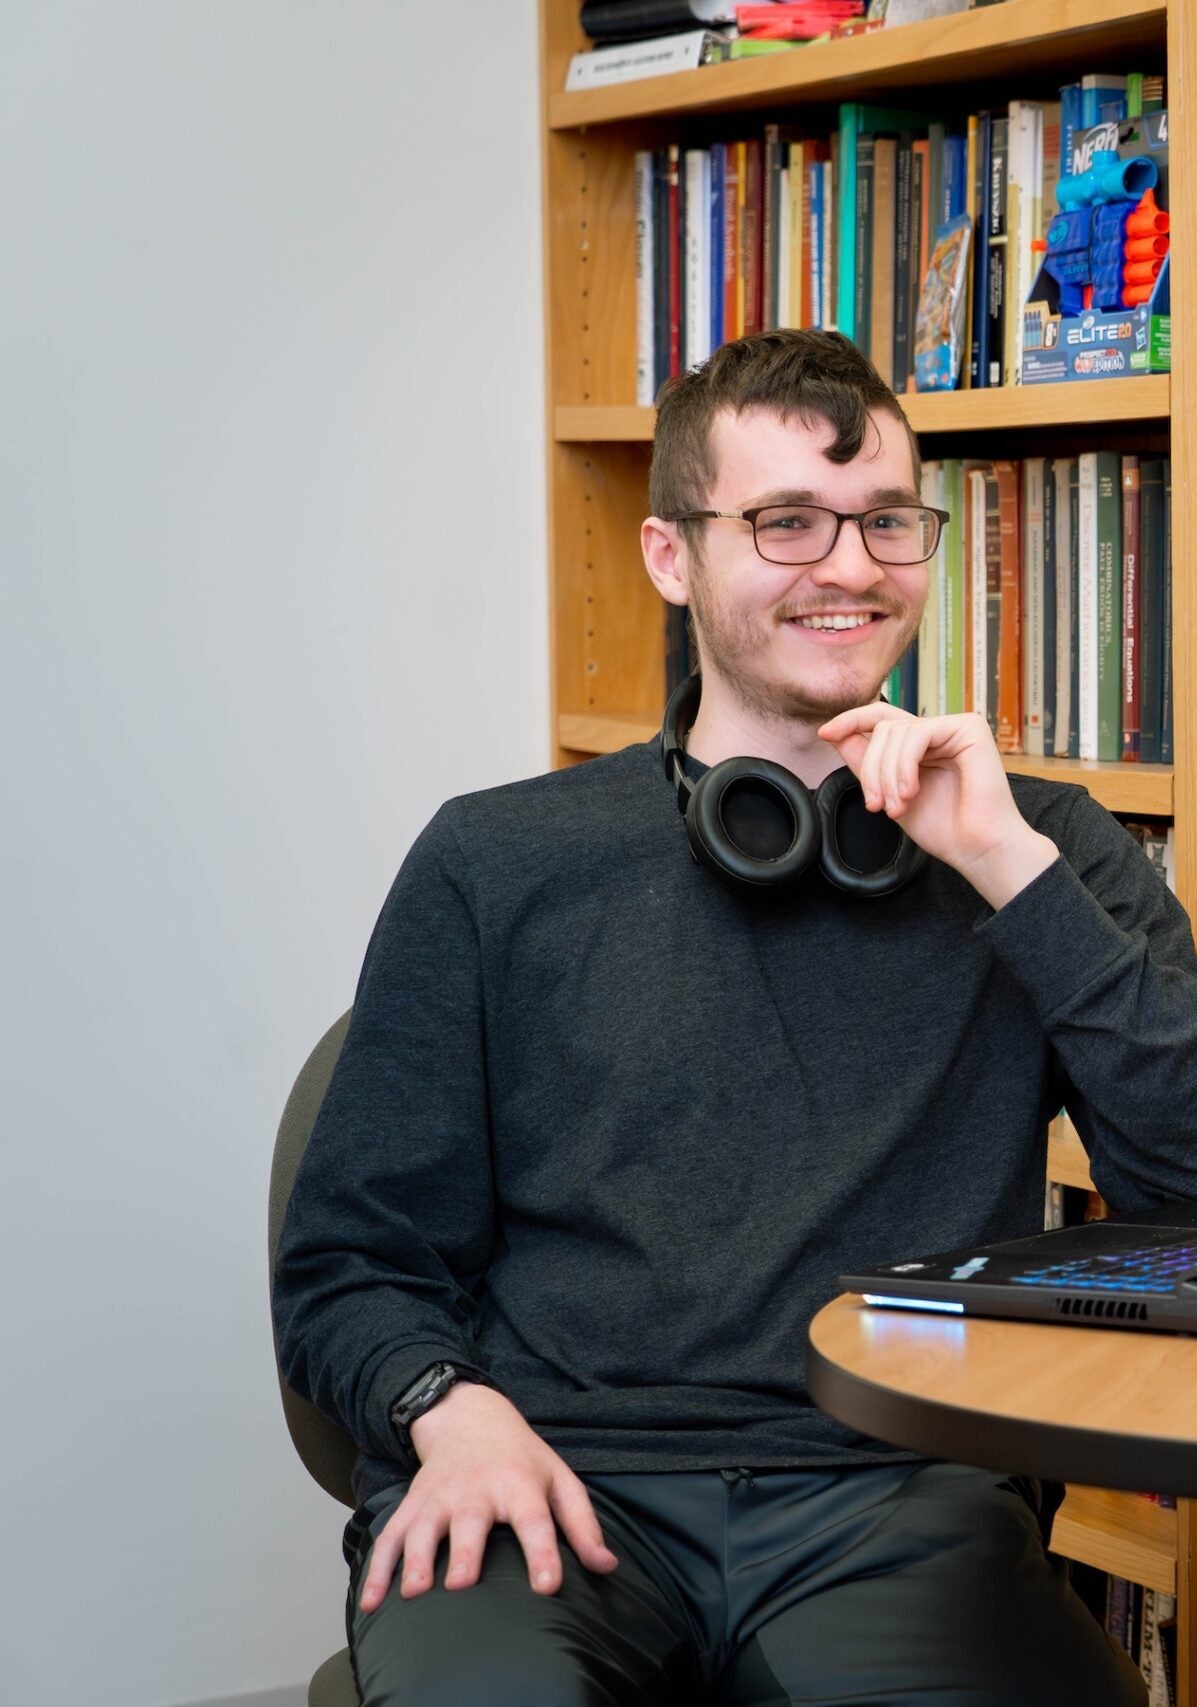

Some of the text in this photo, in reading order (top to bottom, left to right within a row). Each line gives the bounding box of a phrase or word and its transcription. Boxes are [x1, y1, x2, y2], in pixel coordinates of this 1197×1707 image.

[1072, 123, 1119, 176] NERF
[1067, 323, 1119, 345] ELITE
[1126, 554, 1135, 703] Differential Equations
